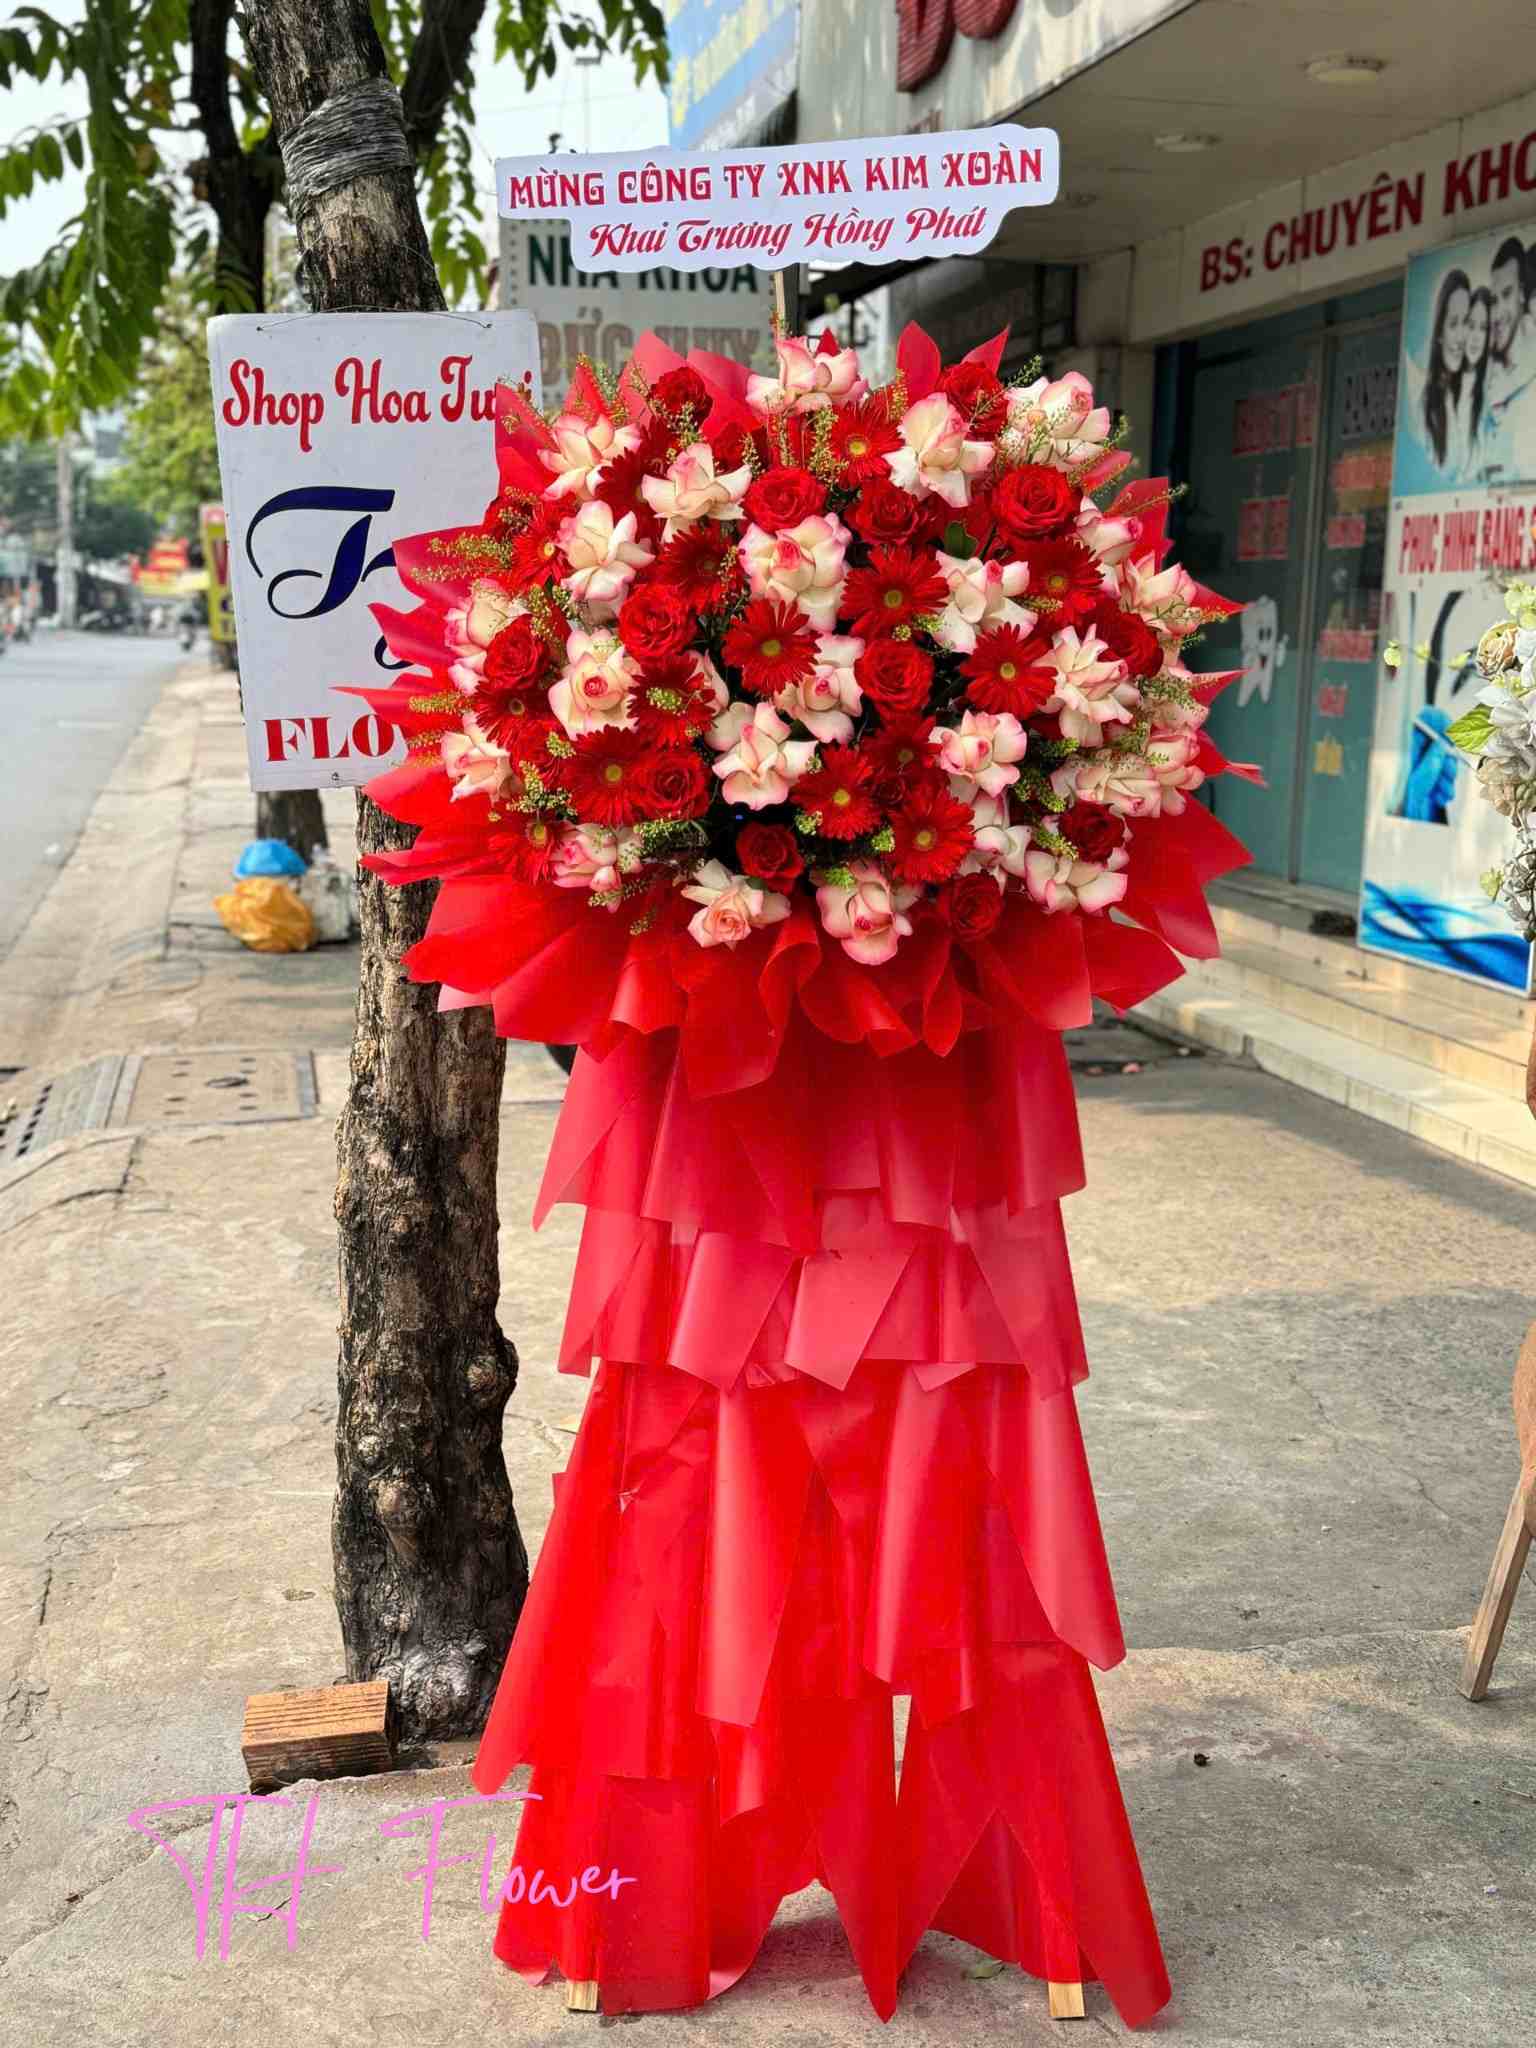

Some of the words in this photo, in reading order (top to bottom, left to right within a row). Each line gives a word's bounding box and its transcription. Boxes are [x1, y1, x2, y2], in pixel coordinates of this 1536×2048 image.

[509, 166, 605, 209] MỪNG
[618, 161, 712, 204] CÔNG
[724, 163, 766, 199] TY
[776, 159, 853, 196] XNK
[864, 154, 929, 192] KIM
[941, 142, 1042, 188] XOÀN
[590, 221, 669, 257] Khai
[676, 218, 793, 256] Trương
[804, 207, 895, 252] Hồng
[1200, 237, 1253, 292] BS:
[1263, 172, 1426, 271] CHUYÊN
[223, 359, 324, 452] Shop
[335, 358, 432, 423] Hoa
